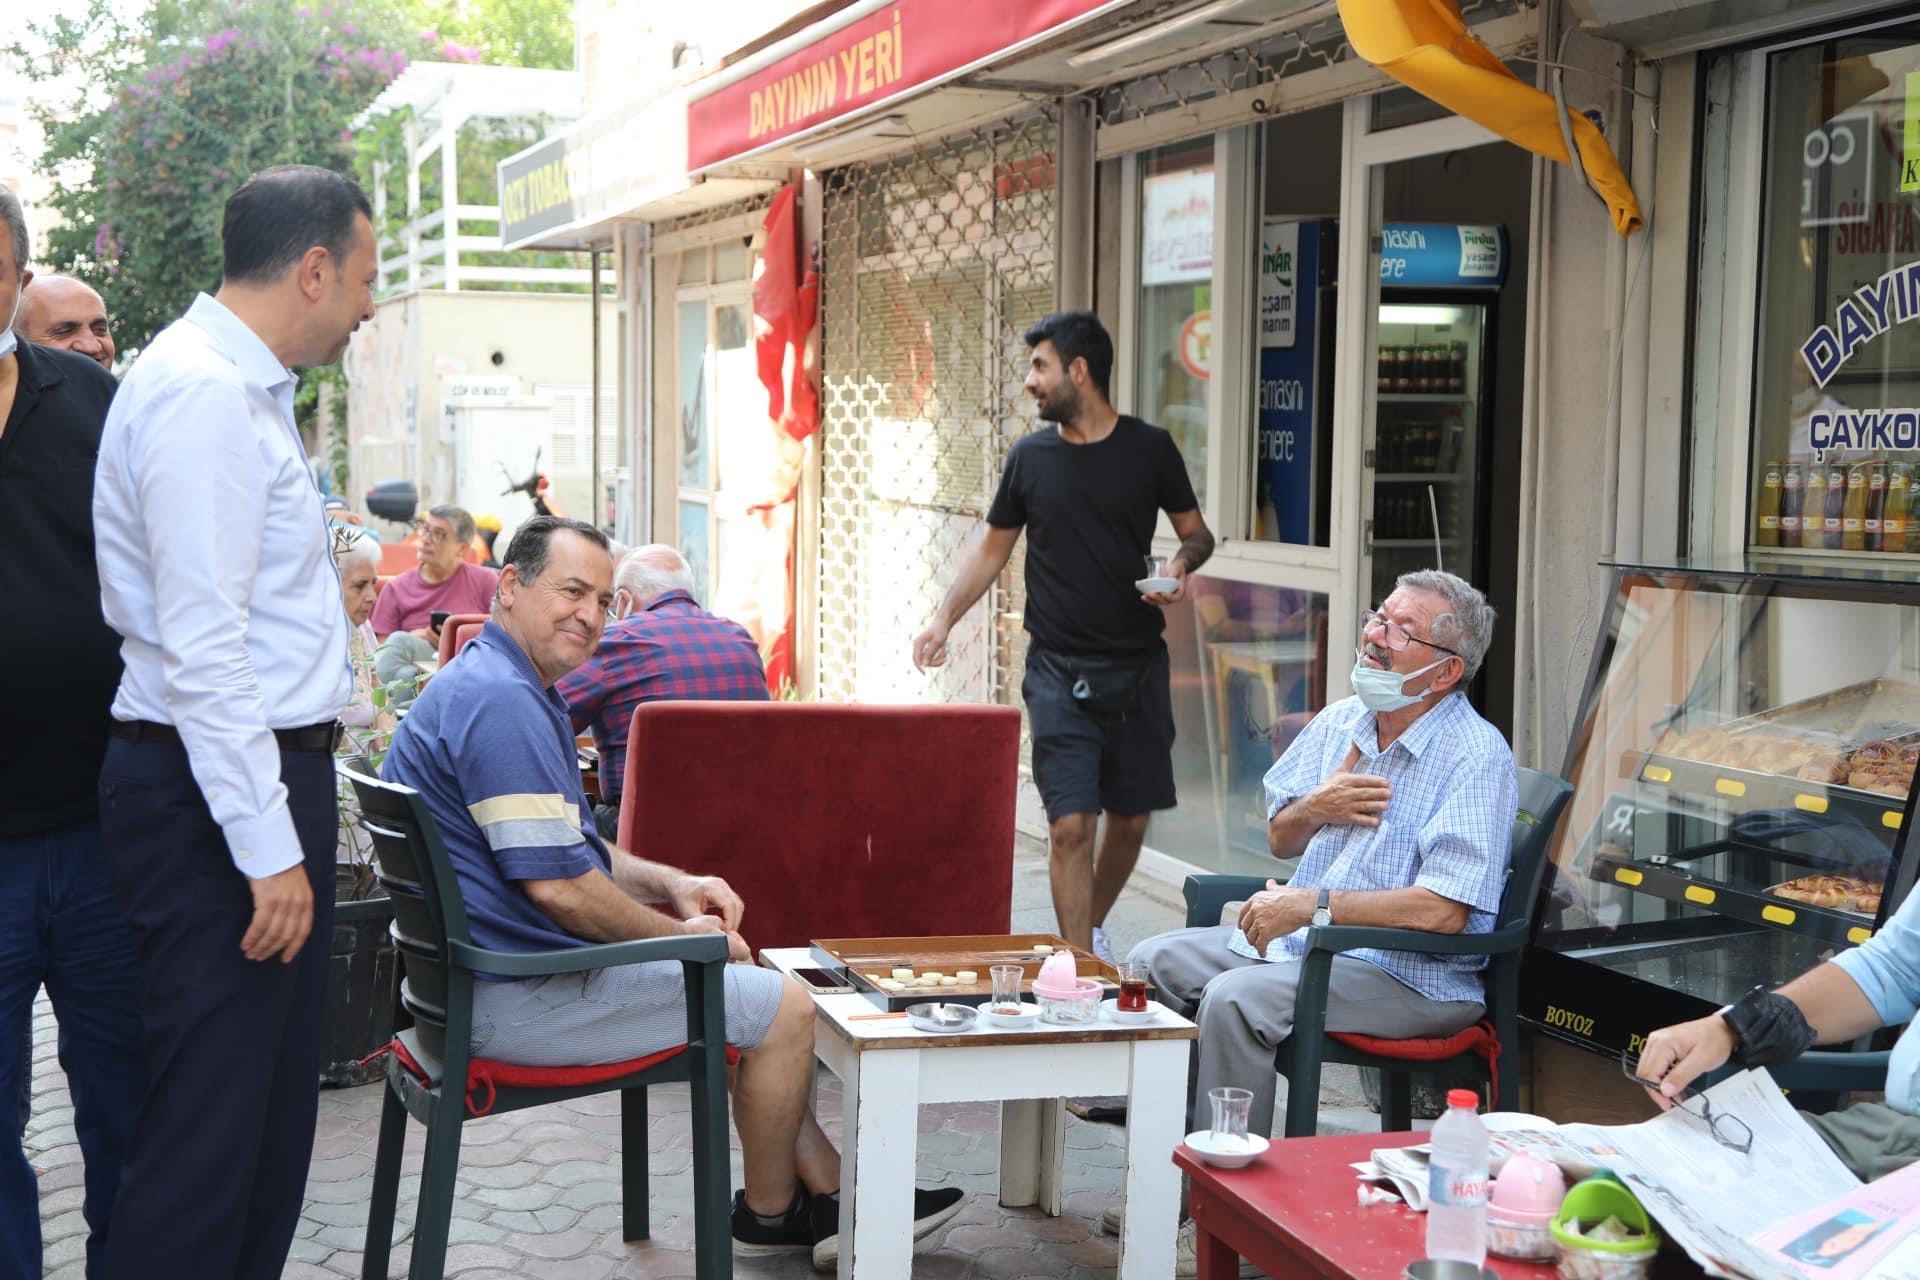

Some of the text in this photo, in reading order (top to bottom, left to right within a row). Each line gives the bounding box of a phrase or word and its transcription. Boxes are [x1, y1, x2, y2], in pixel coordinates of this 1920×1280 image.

[748, 9, 903, 140] DAYININ YERİ
[1836, 188, 1916, 256] SİGARA
[1809, 410, 1920, 463] ÇAYKO
[1544, 1005, 1595, 1037] BOYOZ
